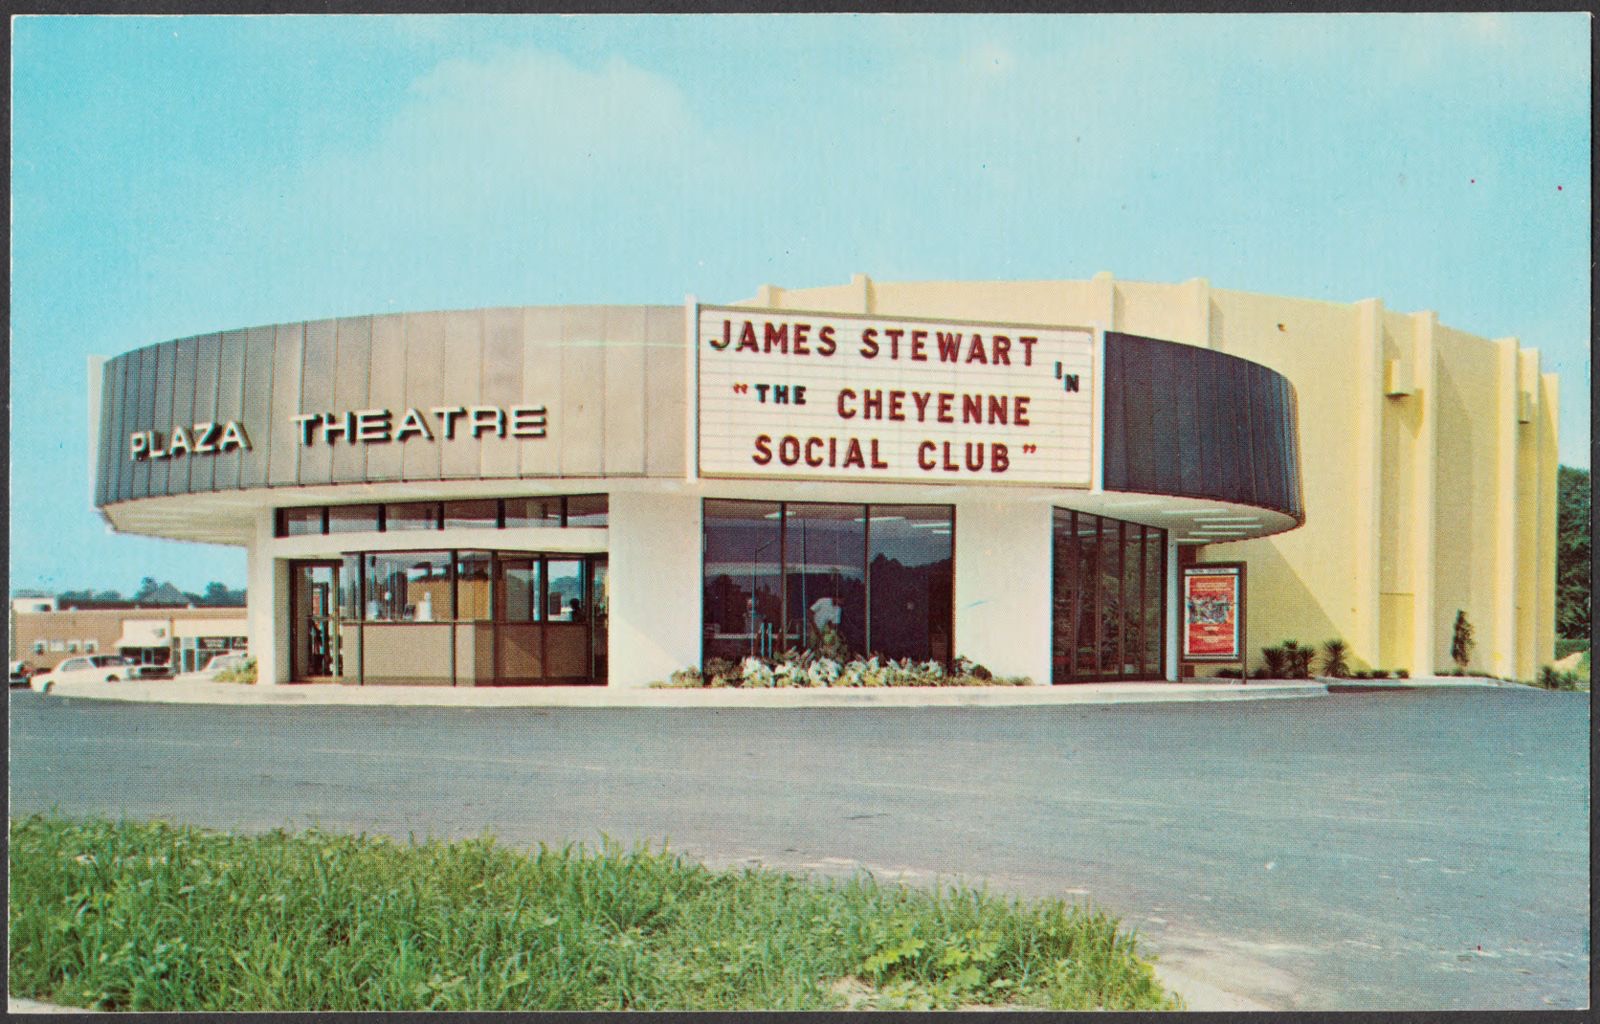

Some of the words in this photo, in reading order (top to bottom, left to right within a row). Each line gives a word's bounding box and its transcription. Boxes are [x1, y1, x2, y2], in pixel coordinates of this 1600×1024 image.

[710, 320, 836, 356] JAMES
[860, 328, 1037, 366] STEWART
[1055, 361, 1079, 392] IN
[837, 389, 1030, 426] CHEYENNE
[130, 420, 251, 461] PLAZA
[292, 404, 547, 446] THEATRE
[752, 434, 888, 469] SOCIAL
